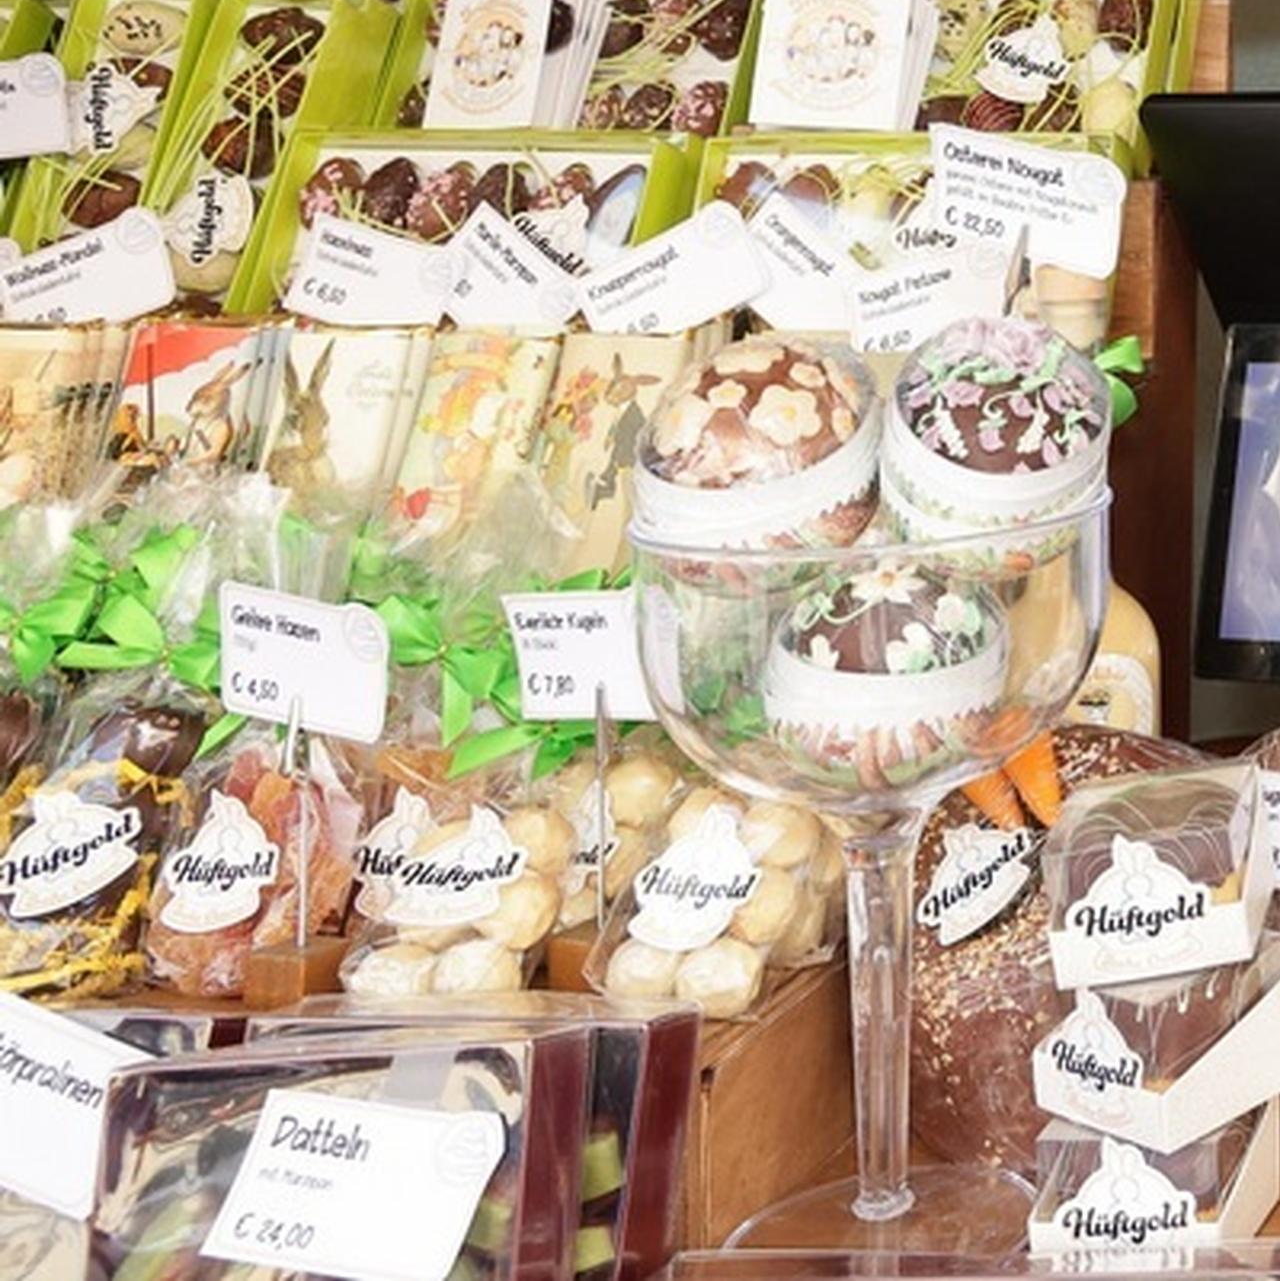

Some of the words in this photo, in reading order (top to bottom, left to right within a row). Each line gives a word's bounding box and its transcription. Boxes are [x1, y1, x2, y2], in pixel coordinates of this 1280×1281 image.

[985, 35, 1066, 85] Hüftgold
[1006, 156, 1066, 188] Nougat
[945, 206, 958, 227] €
[231, 671, 243, 694] €
[528, 672, 541, 695] €
[543, 674, 576, 696] 7,80
[1, 813, 136, 887] Hüftgold
[171, 850, 274, 892] Hüftgold
[400, 850, 521, 892] Hüftgold
[642, 865, 757, 909] Hüftgold
[923, 835, 1029, 917] Hüftgold
[1075, 892, 1206, 938] Hüftgold
[1052, 1039, 1138, 1092] Hüftgold
[271, 1113, 371, 1163] Datteln
[233, 1210, 254, 1238] €
[258, 1211, 314, 1252] 24,00
[1062, 1199, 1190, 1245] Hüftgold
